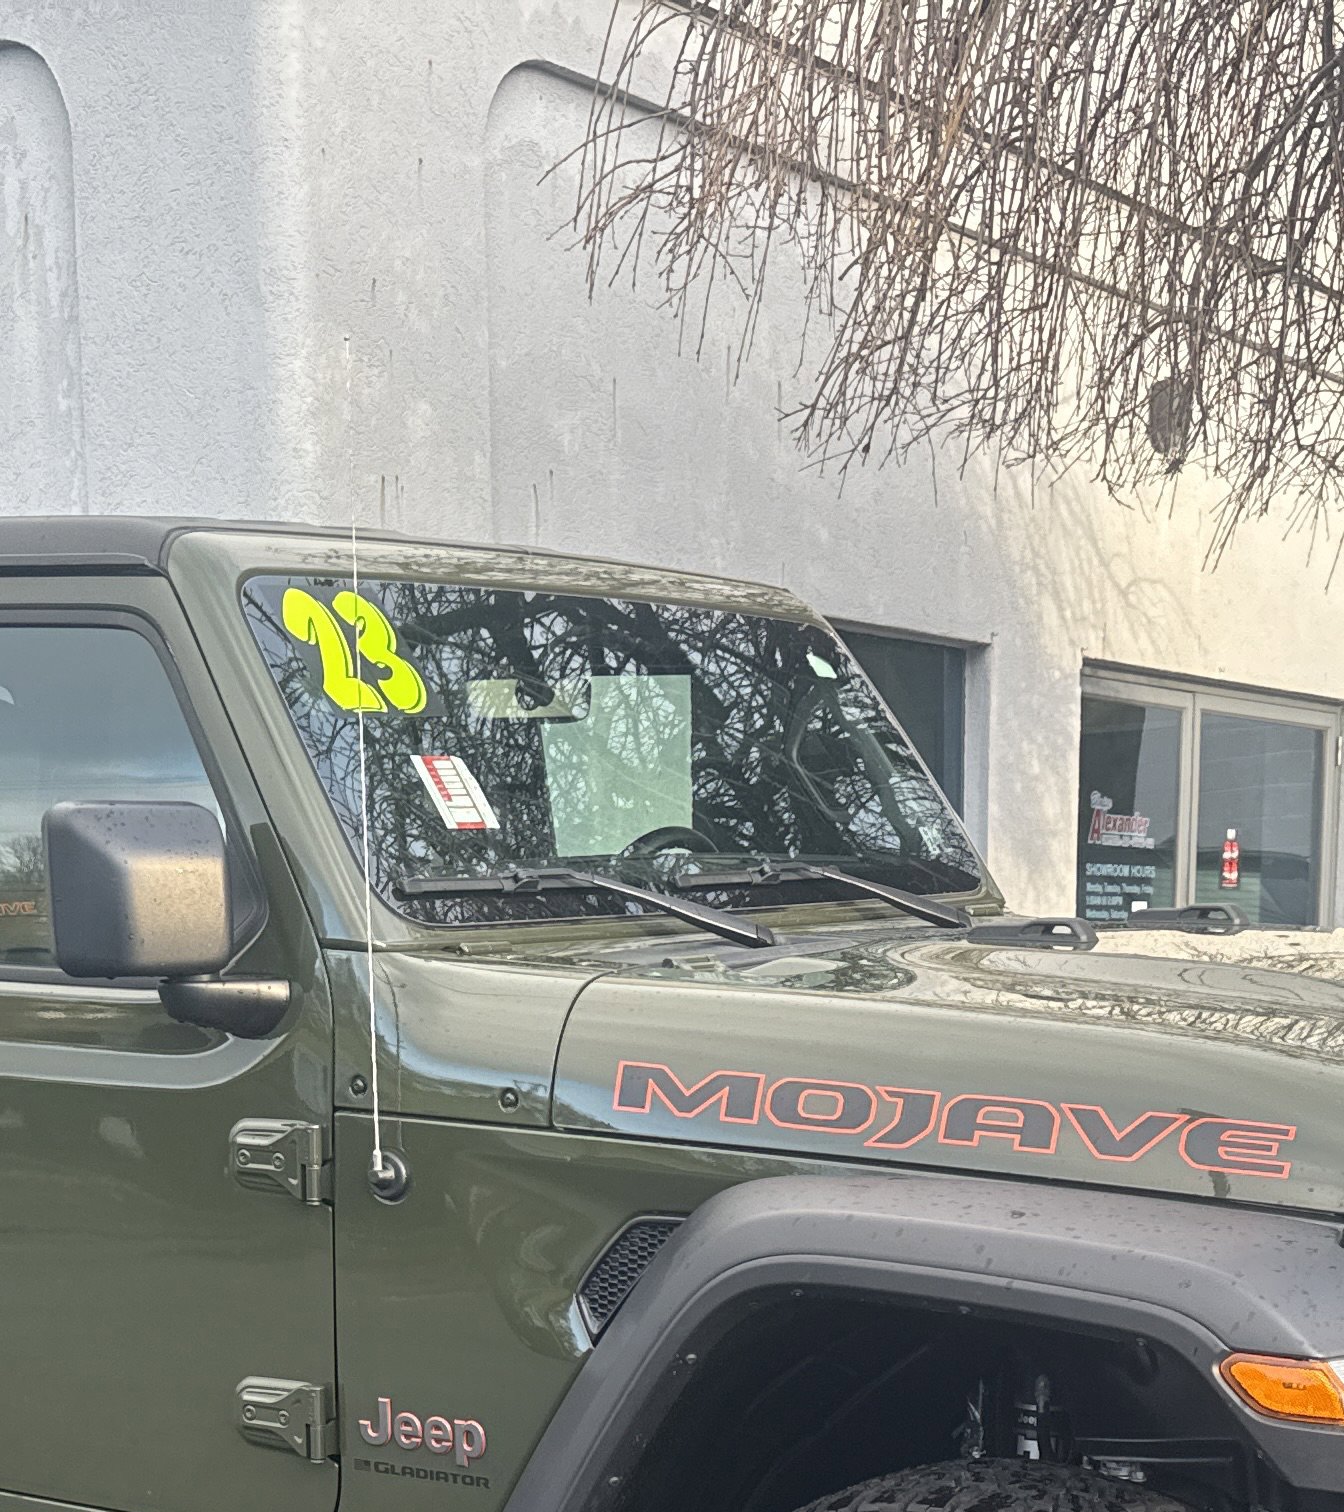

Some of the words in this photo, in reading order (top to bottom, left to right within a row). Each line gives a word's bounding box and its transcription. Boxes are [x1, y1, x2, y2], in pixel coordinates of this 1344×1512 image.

[282, 587, 427, 714] 23
[613, 1060, 1297, 1180] MOJAVE
[358, 1396, 488, 1468] Jeep
[373, 1460, 491, 1490] GLADIATOR
